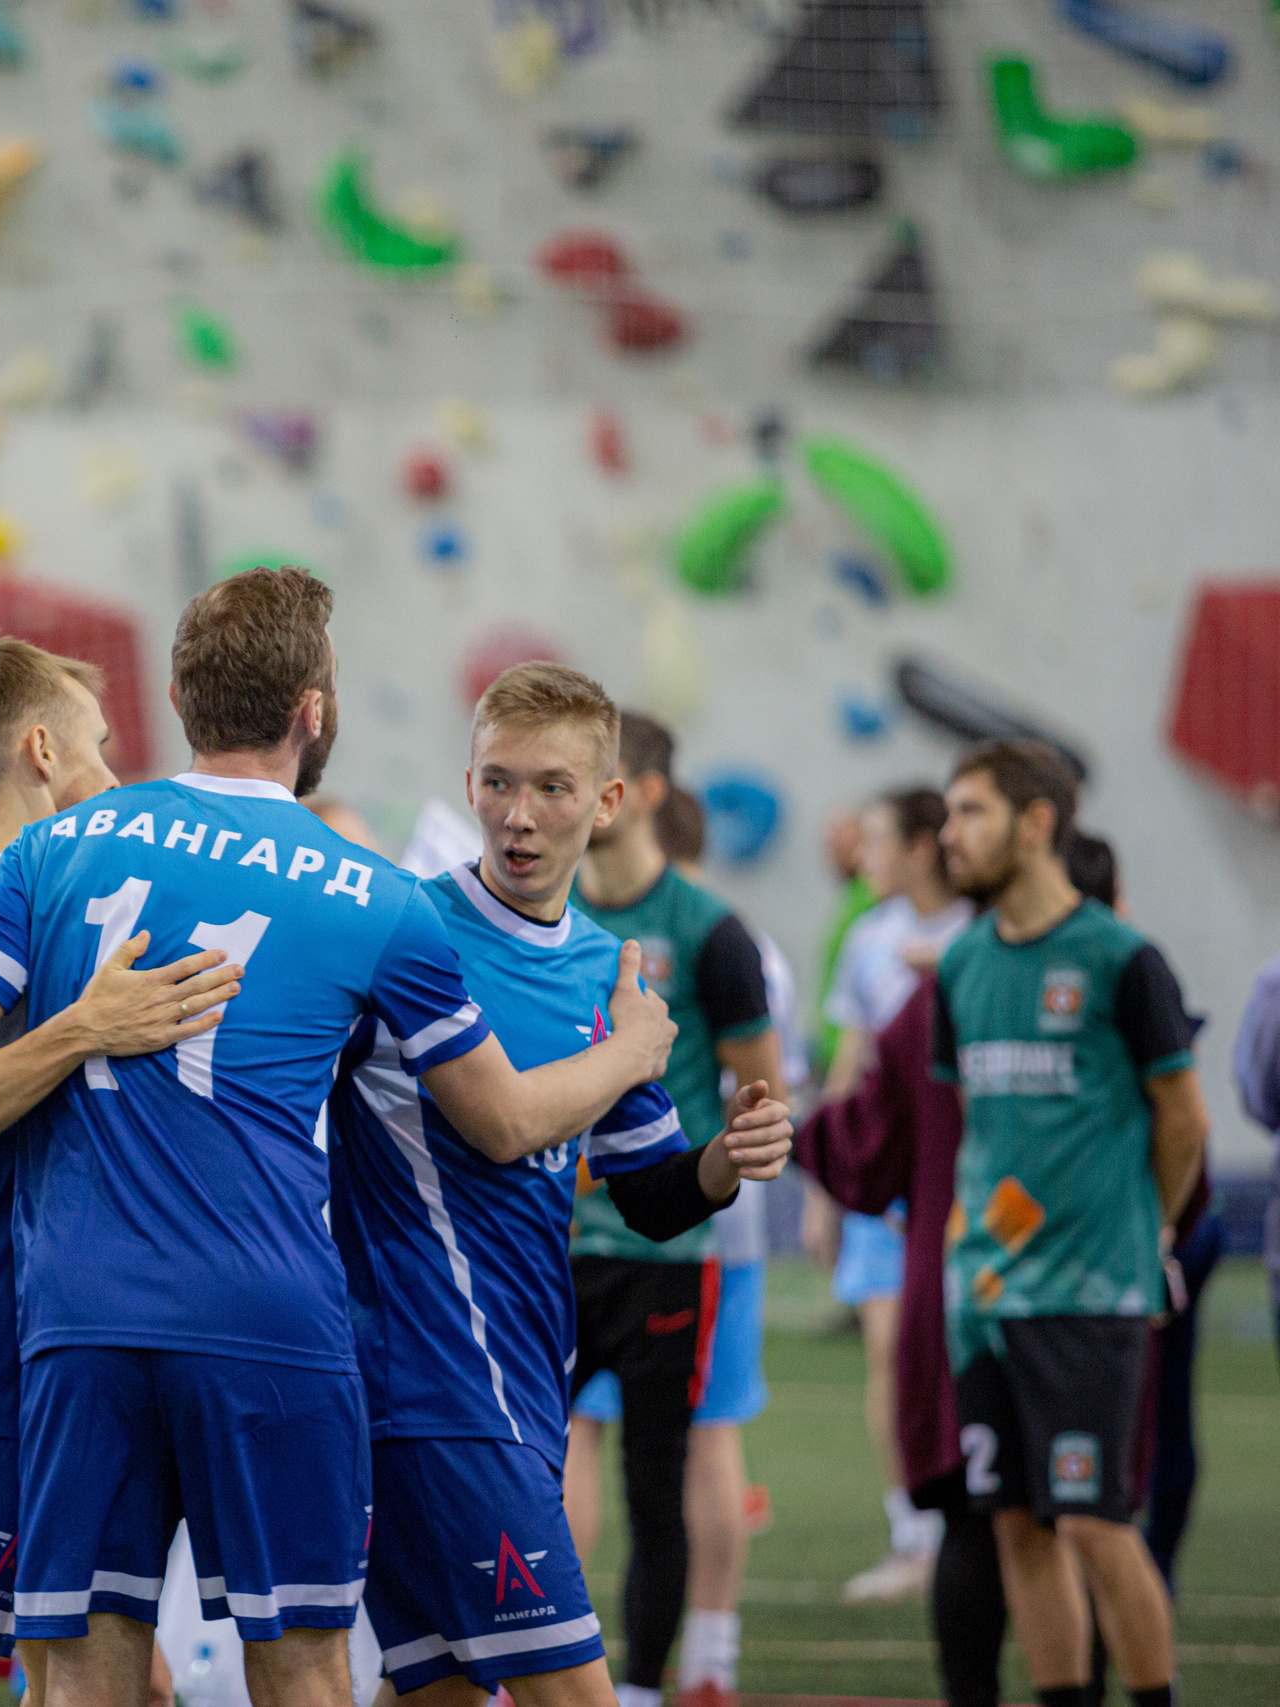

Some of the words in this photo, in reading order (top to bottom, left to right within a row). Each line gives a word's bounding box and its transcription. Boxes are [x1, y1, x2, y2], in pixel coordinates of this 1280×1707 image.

[50, 809, 373, 907] АВАНГАРД
[84, 876, 272, 1100] 11
[959, 1422, 1003, 1496] 2
[494, 1605, 557, 1622] АВАНГАРД
